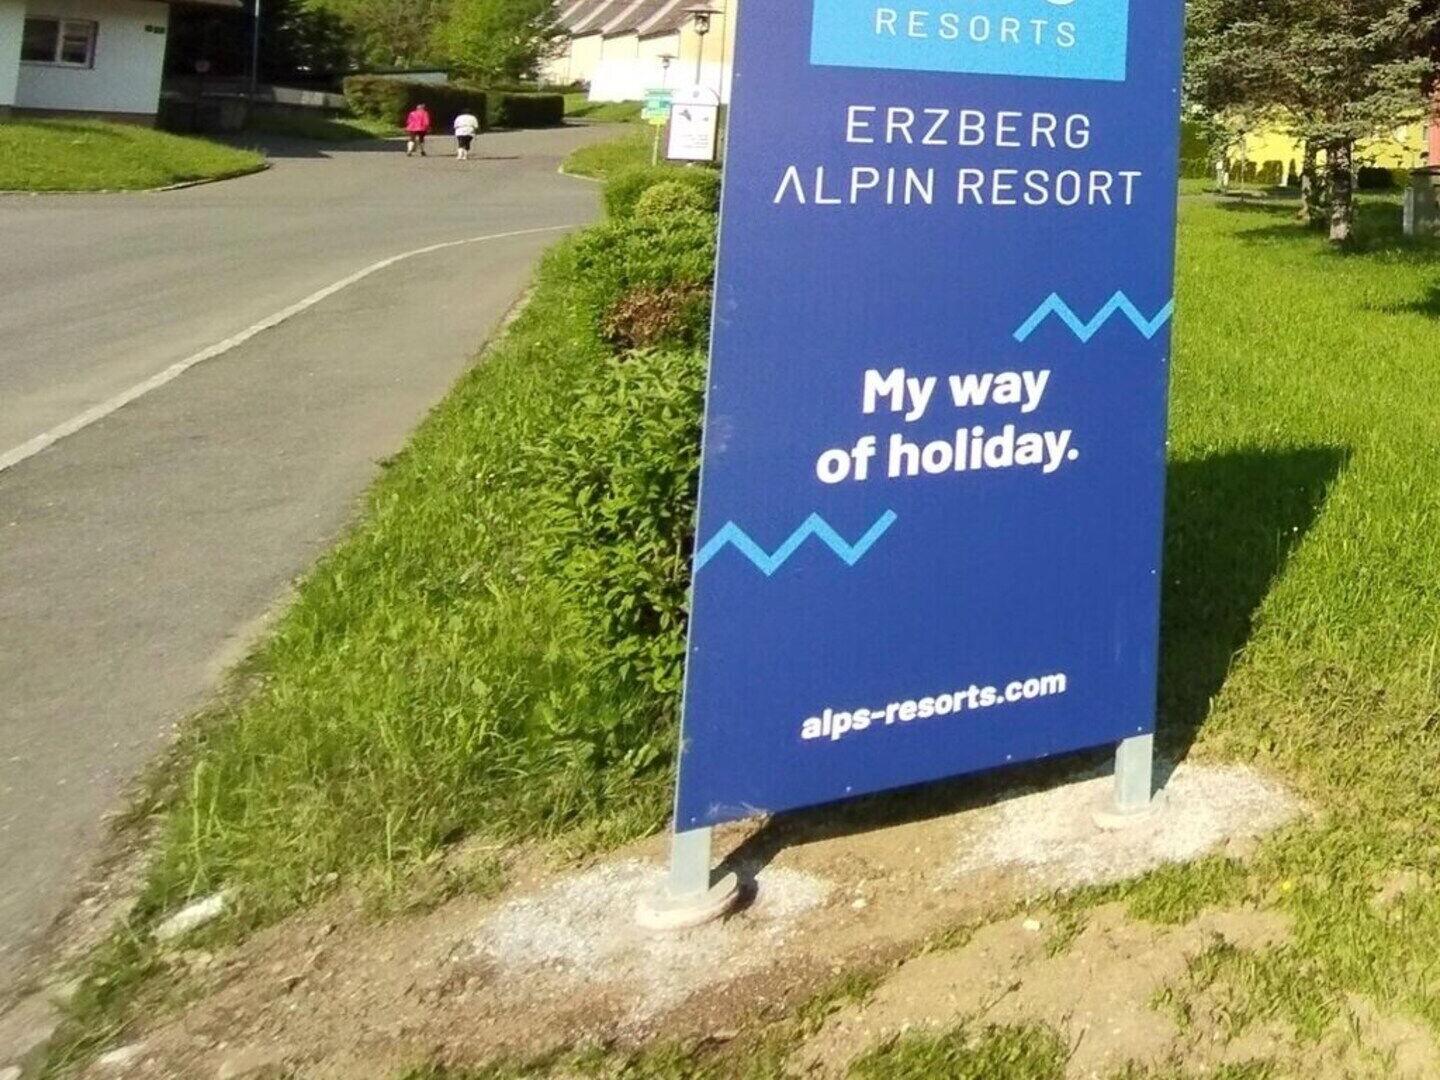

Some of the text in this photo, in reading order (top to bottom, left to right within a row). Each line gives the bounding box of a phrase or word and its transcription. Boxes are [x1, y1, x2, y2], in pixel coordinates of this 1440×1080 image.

[874, 8, 1076, 47] RESORTS
[845, 105, 1091, 149] ERZBERG
[773, 166, 1141, 206] ALPIN RESORT
[863, 367, 1051, 420] My way
[816, 425, 1079, 484] of holiday.
[801, 672, 1066, 740] alps-resorts.com
